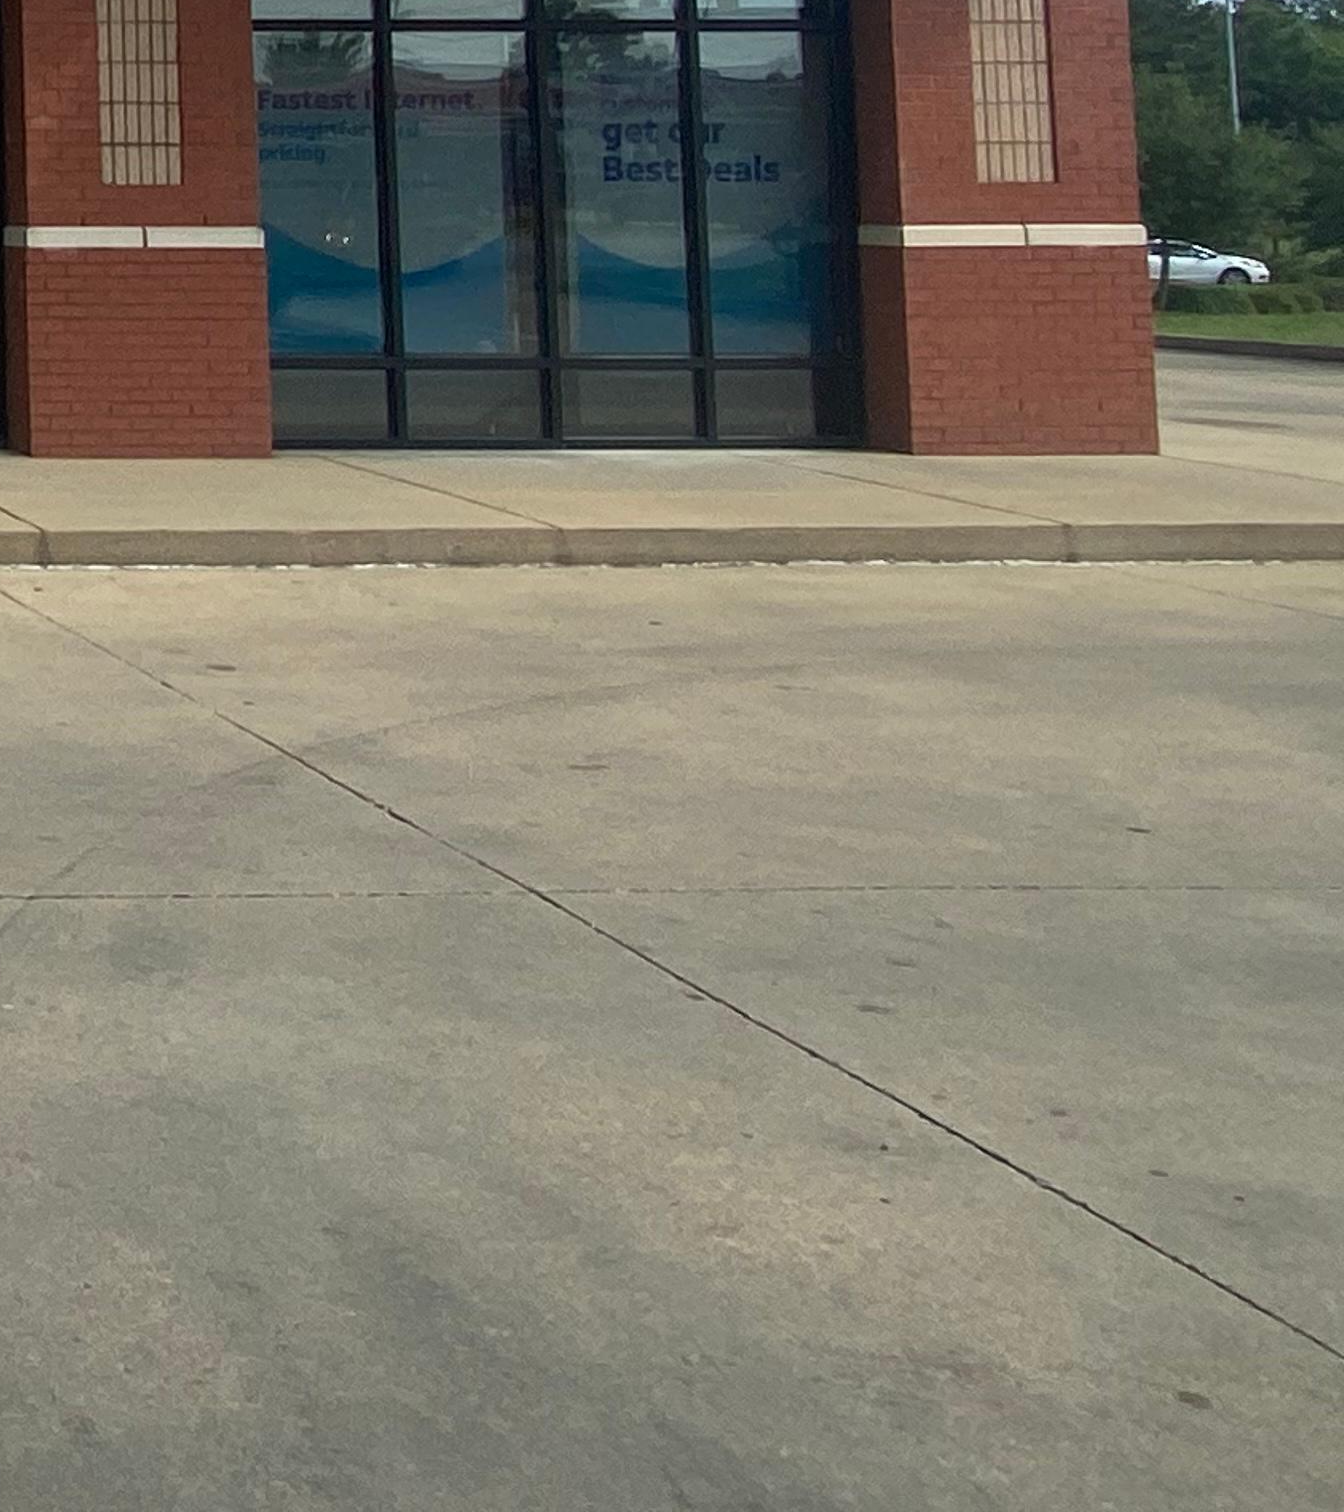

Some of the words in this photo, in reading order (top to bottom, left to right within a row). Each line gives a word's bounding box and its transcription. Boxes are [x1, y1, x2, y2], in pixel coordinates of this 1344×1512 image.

[257, 89, 356, 110] Fastest
[602, 120, 660, 151] get
[603, 155, 680, 182] Best
[692, 154, 780, 182] eals
